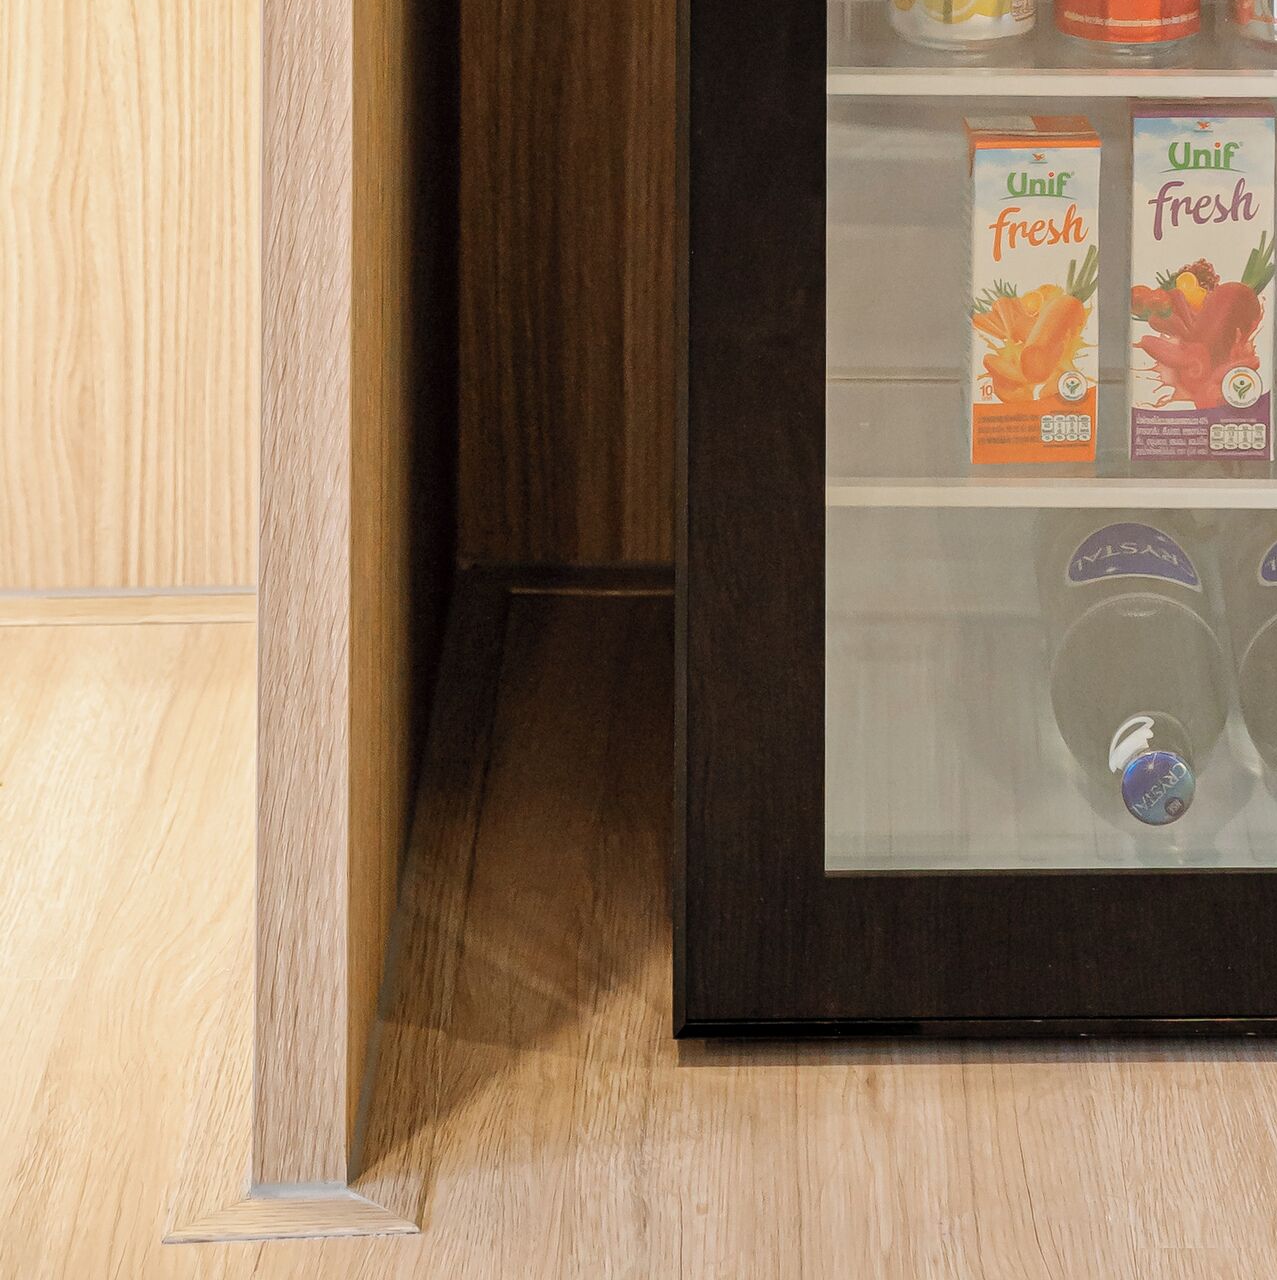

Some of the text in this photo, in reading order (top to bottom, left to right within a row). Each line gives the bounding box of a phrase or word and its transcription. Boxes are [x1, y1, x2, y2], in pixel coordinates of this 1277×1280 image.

[1167, 142, 1241, 170] Unif
[1006, 171, 1072, 197] Unif
[1147, 177, 1260, 241] fresh
[988, 203, 1089, 262] fresh
